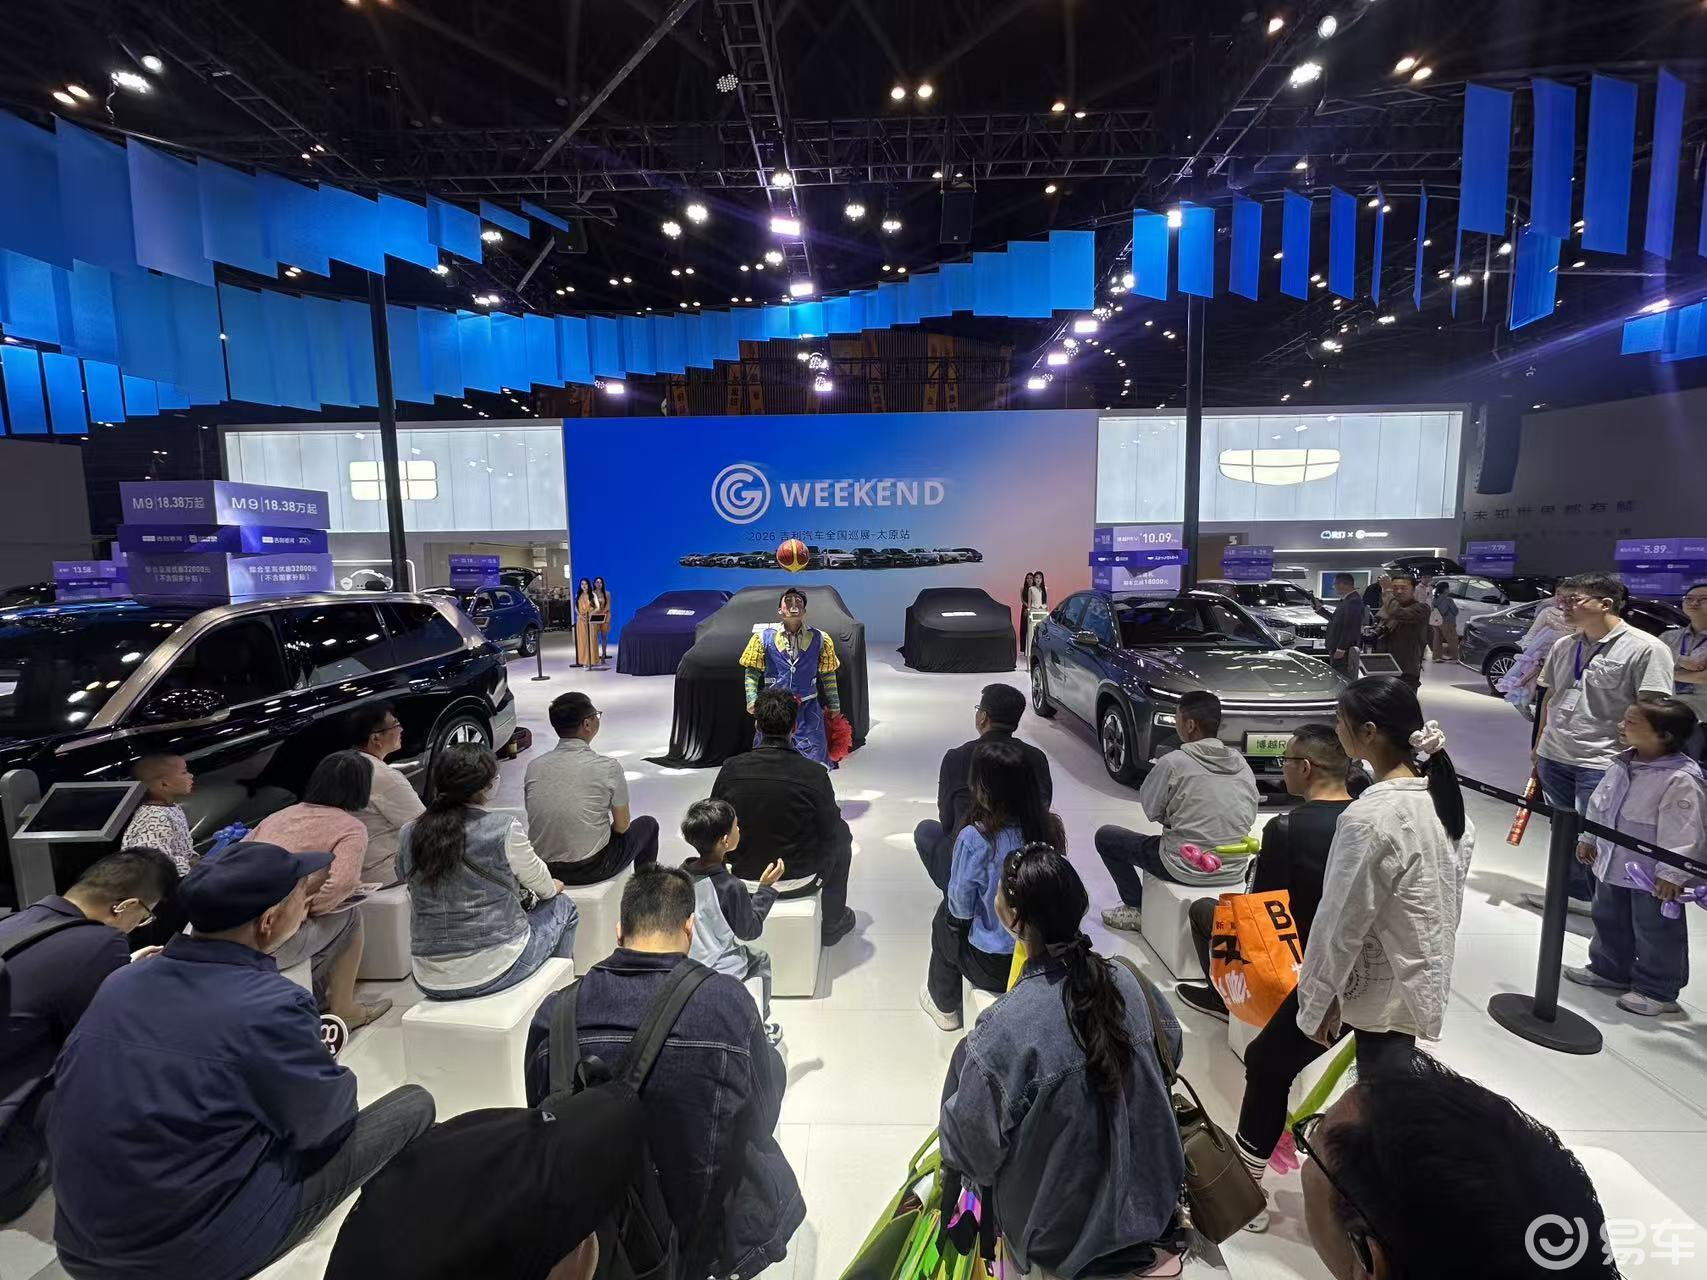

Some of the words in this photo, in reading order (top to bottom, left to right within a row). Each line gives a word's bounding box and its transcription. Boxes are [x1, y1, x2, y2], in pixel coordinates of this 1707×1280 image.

[780, 481, 945, 507] WEEKEND
[132, 498, 153, 509] M9
[231, 497, 258, 510] M9
[263, 499, 318, 515] 18.38万起
[750, 531, 776, 541] 2026
[1143, 532, 1172, 543] 10.09
[1643, 545, 1667, 553] 5.89
